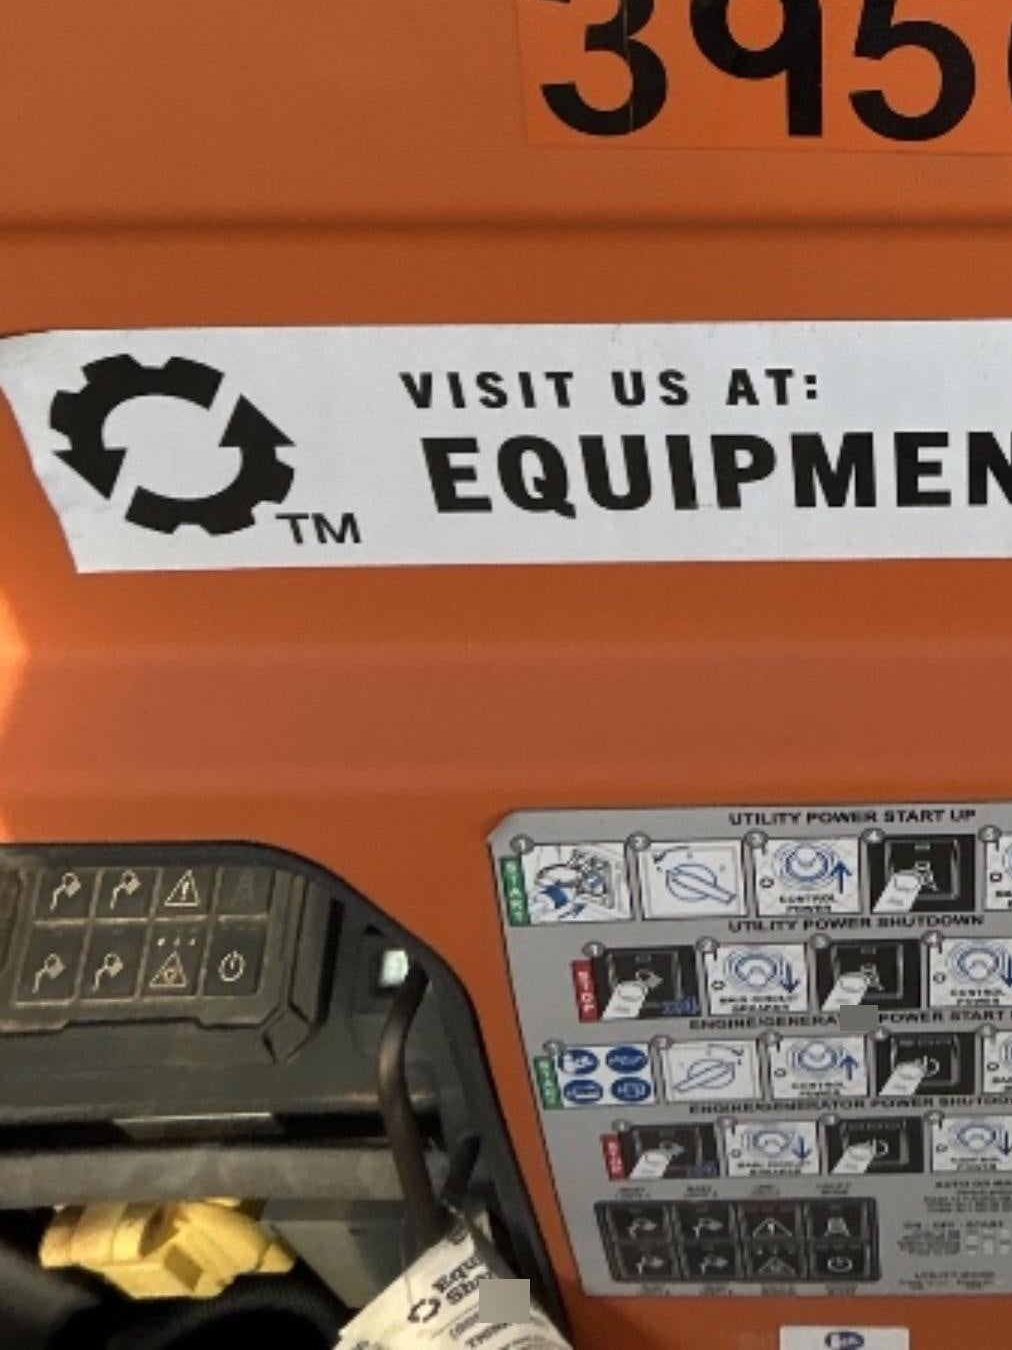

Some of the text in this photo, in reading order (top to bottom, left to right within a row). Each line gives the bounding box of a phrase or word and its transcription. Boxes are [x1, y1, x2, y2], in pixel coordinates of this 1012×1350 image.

[400, 368, 819, 409] VISIT US AT:
[275, 512, 362, 545] TM
[689, 1013, 840, 1031] ENGINE/GENERA
